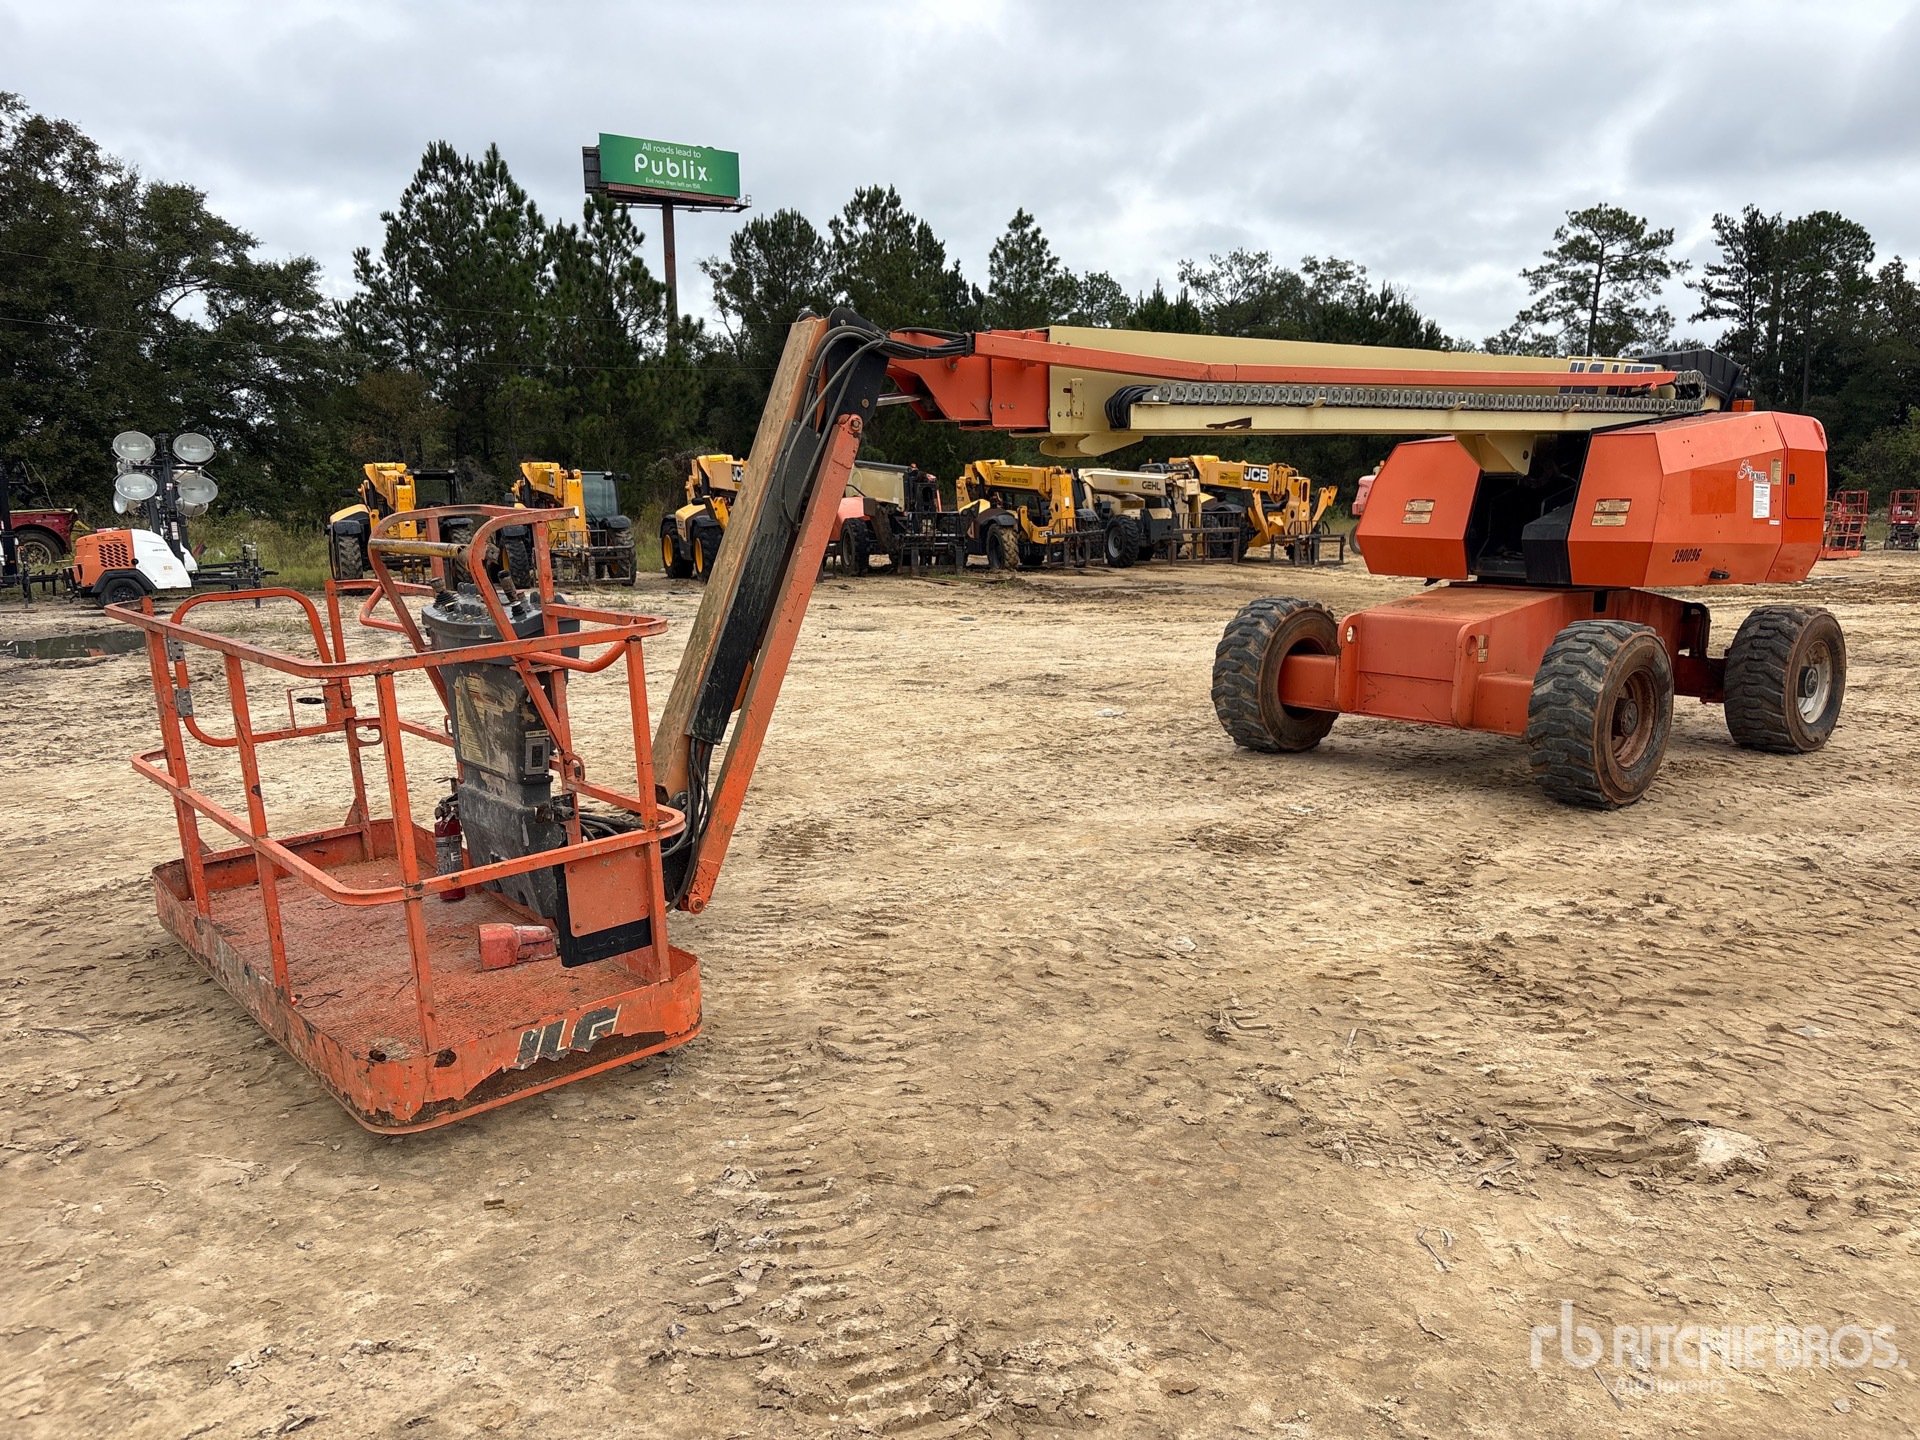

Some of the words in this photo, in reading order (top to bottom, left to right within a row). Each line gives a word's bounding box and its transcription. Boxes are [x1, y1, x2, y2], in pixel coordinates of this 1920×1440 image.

[642, 142, 652, 152] All
[653, 145, 675, 155] roads
[676, 147, 692, 157] lead
[693, 150, 702, 159] to
[634, 153, 709, 182] Publix
[1243, 467, 1269, 482] JCB
[1141, 480, 1162, 491] GEHL
[1671, 548, 1702, 563] 390096
